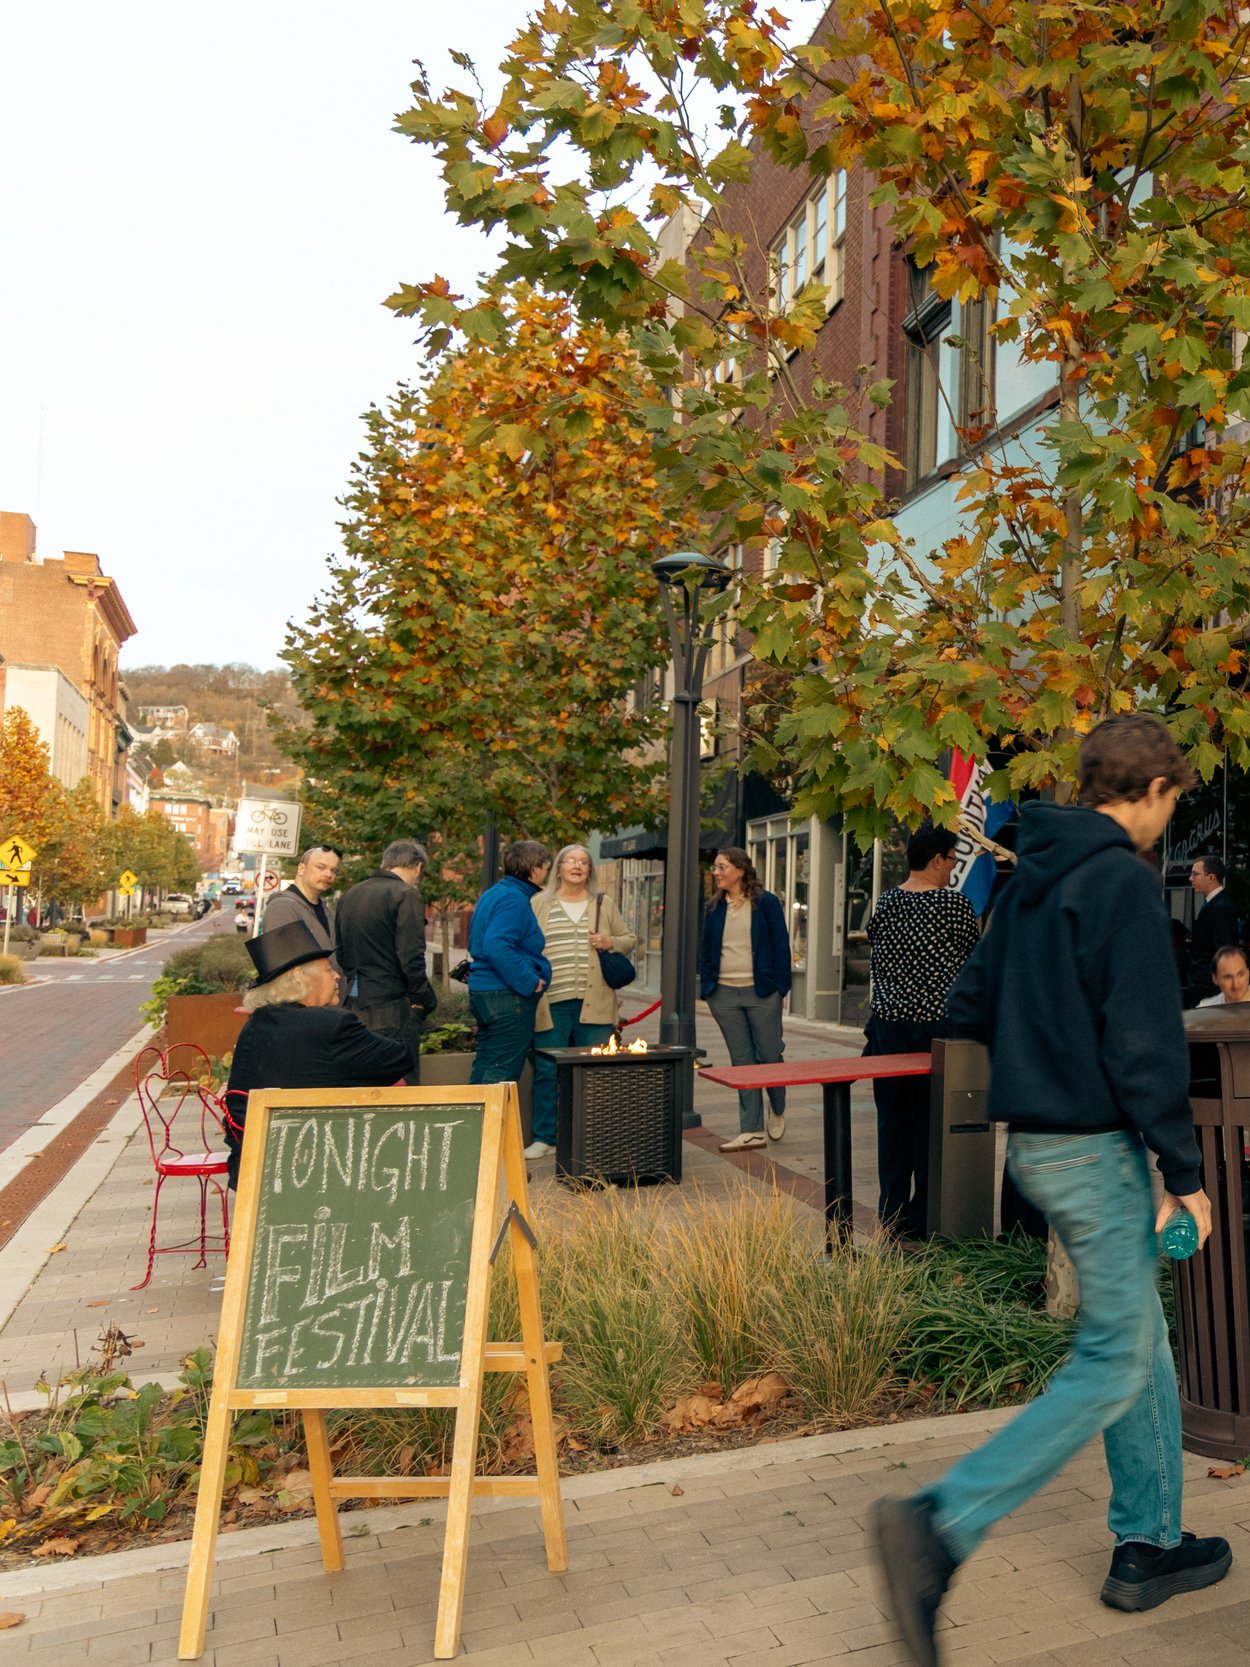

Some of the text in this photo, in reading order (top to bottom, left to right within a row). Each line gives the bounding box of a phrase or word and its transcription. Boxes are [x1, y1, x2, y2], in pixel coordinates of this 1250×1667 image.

[269, 840, 292, 850] LANE
[271, 828, 288, 838] USE
[270, 1112, 465, 1206] TONIGHT
[258, 1206, 416, 1328] FILM
[251, 1277, 462, 1379] FESTIVAL
